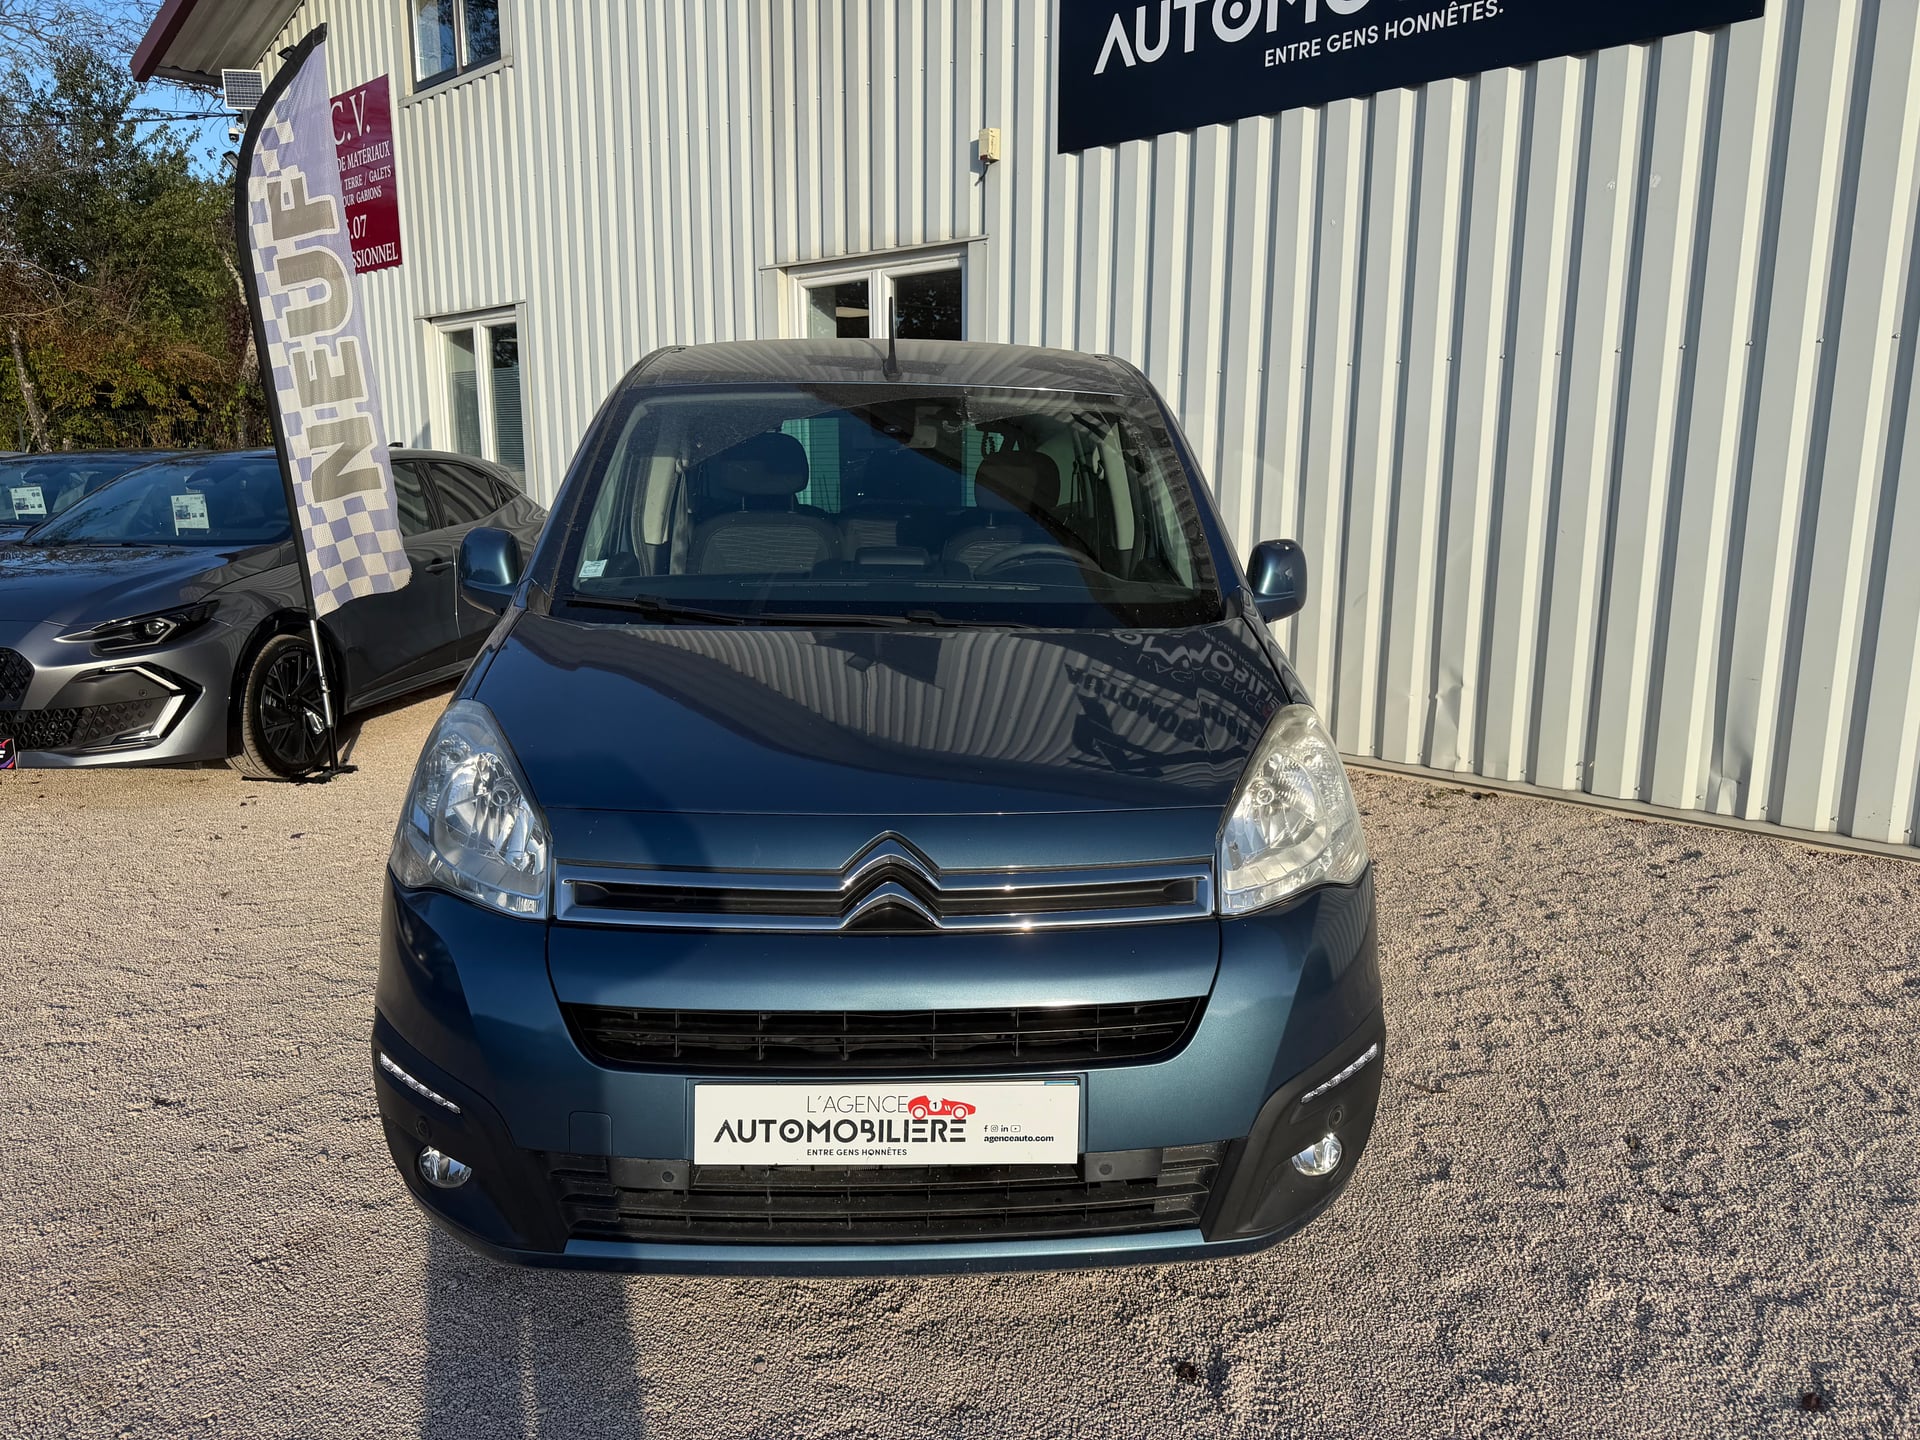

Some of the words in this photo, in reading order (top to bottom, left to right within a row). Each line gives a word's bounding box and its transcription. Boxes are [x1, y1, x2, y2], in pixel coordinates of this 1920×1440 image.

[1264, 38, 1321, 67] ENTRE
[1326, 25, 1378, 53] GENS
[1385, 0, 1504, 40] HONNÊTES.
[347, 140, 390, 170] MATÉRIAUX
[344, 174, 363, 190] TERRE
[369, 164, 391, 183] GALETS
[356, 185, 382, 203] GABIONS
[347, 214, 367, 239] .07
[265, 175, 386, 505] NEUF
[807, 1095, 908, 1113] L'AGENCE
[807, 1149, 834, 1157] ENTRE
[836, 1149, 860, 1157] GENS
[861, 1146, 908, 1157] HONNÊTES
[983, 1134, 1055, 1144] agenceauto.com
